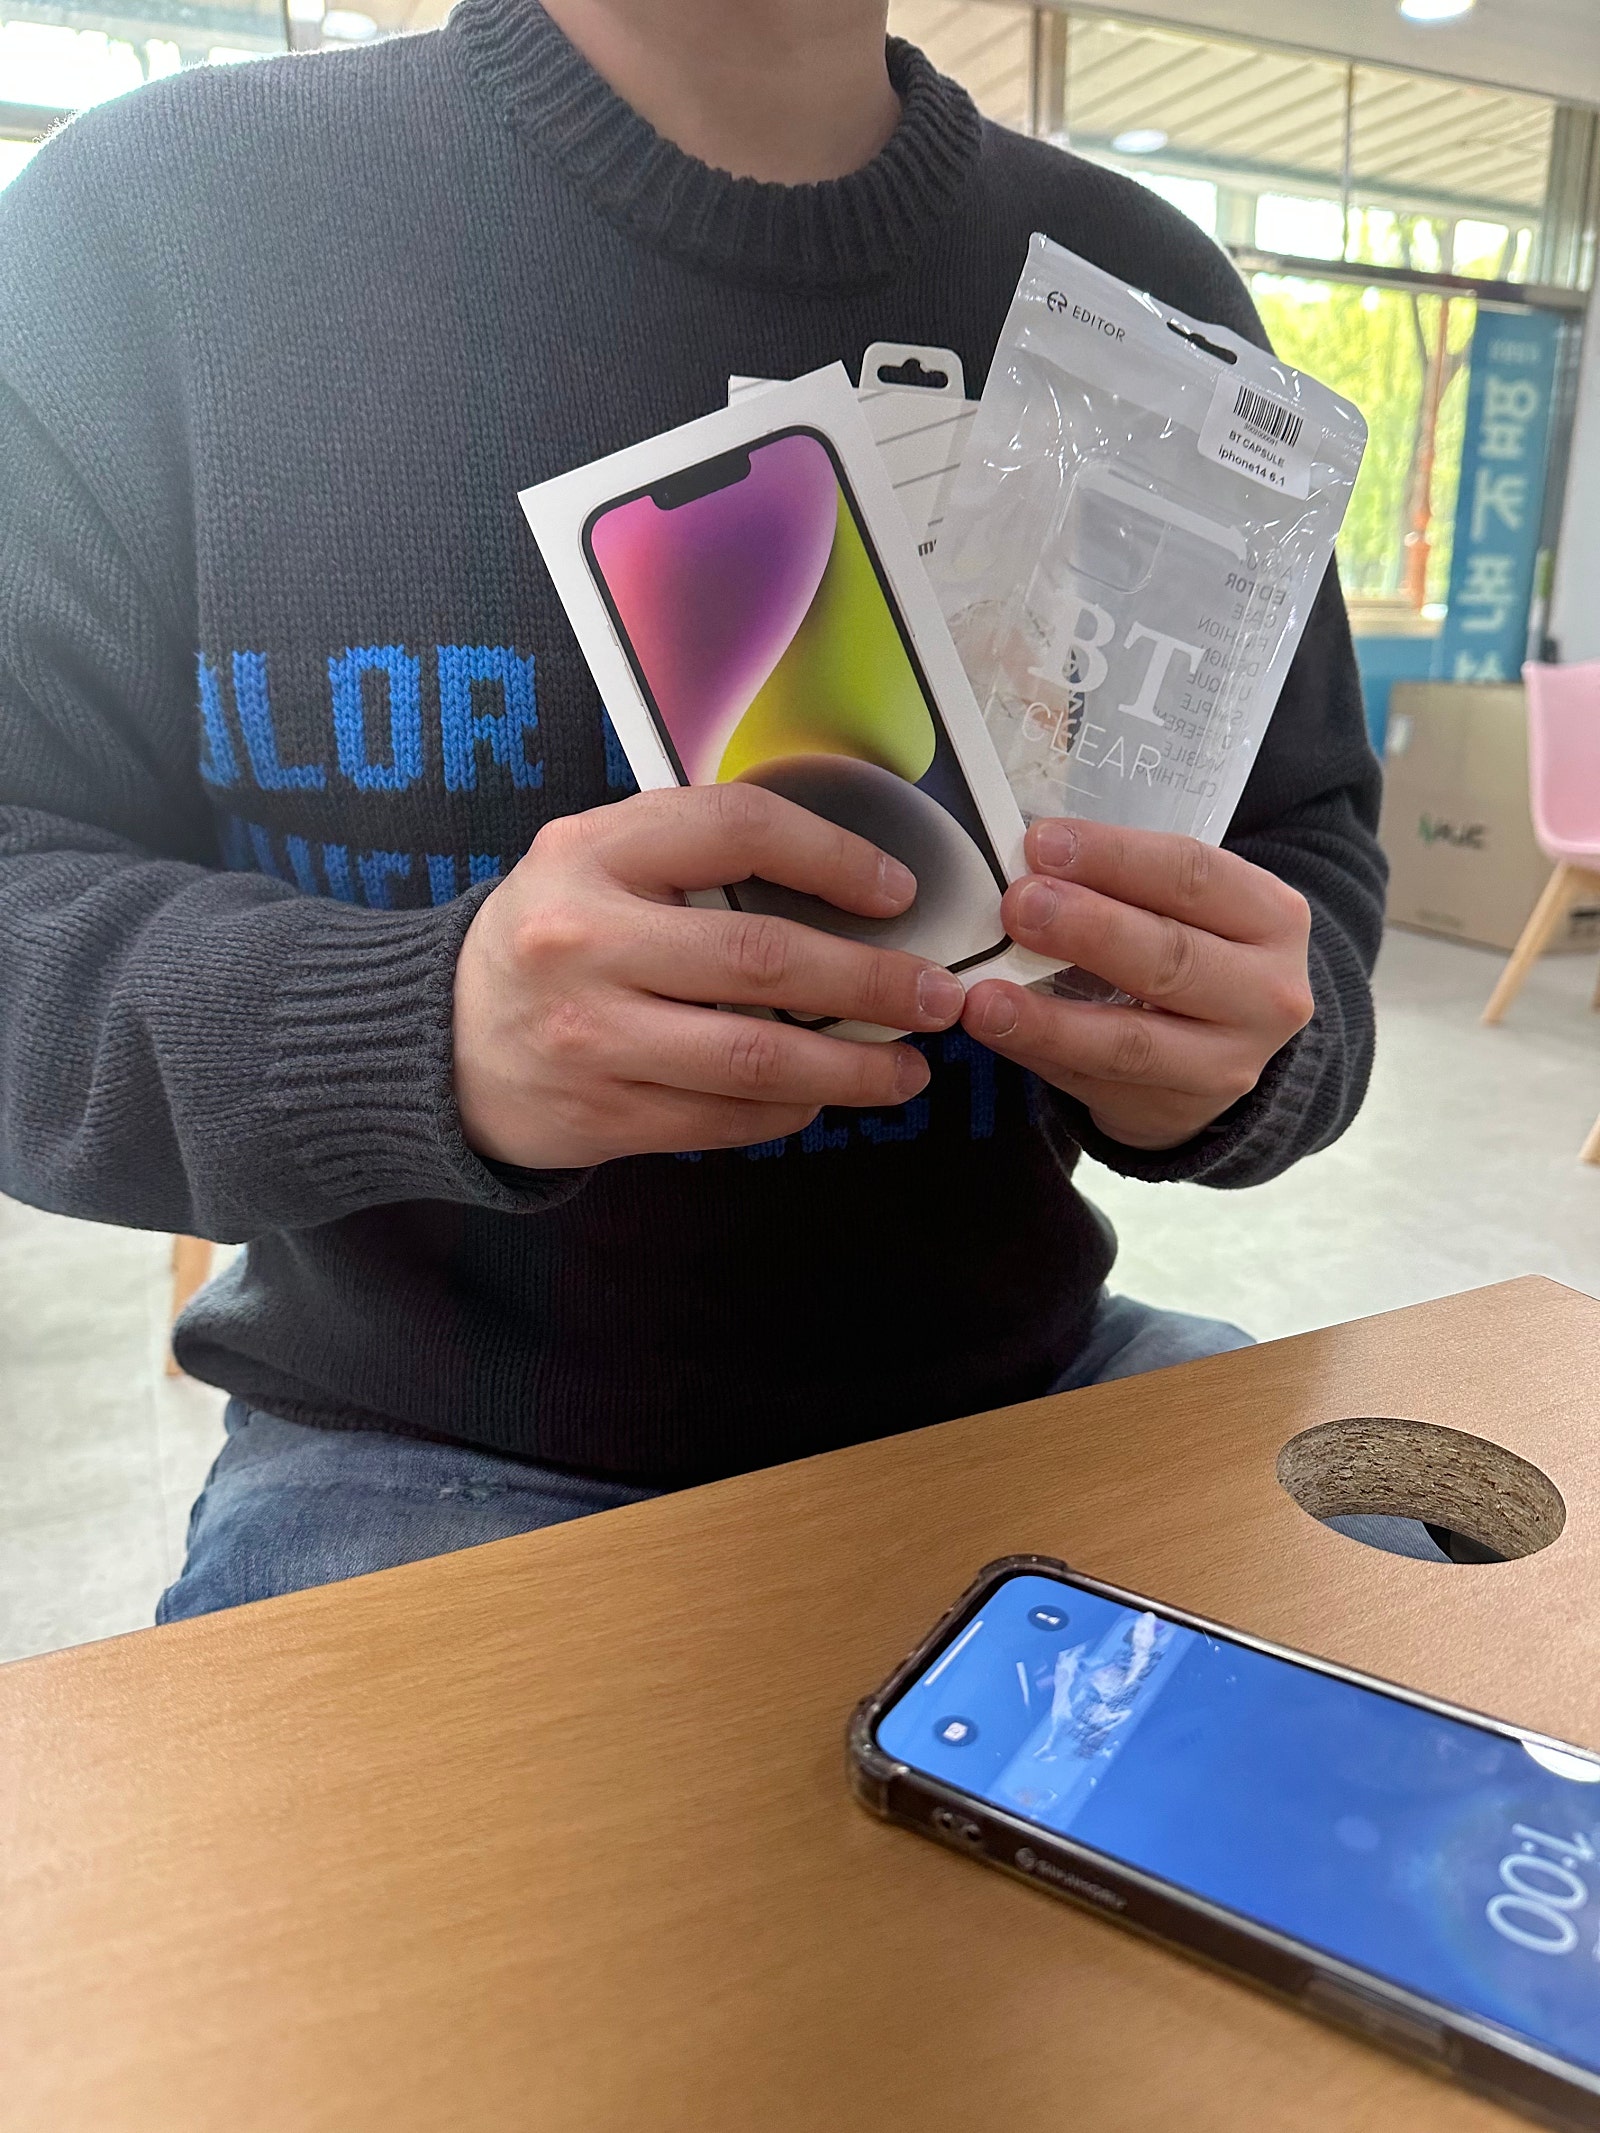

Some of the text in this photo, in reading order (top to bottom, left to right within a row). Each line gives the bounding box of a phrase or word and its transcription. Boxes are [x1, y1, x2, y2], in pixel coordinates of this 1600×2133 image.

[1072, 304, 1126, 342] EDITOR
[1228, 430, 1286, 467] BT CAPSULE
[1269, 469, 1286, 487] 6.1
[1027, 596, 1207, 727] BT
[1022, 701, 1163, 788] CLEAR
[1485, 1823, 1596, 1955] 1:00
